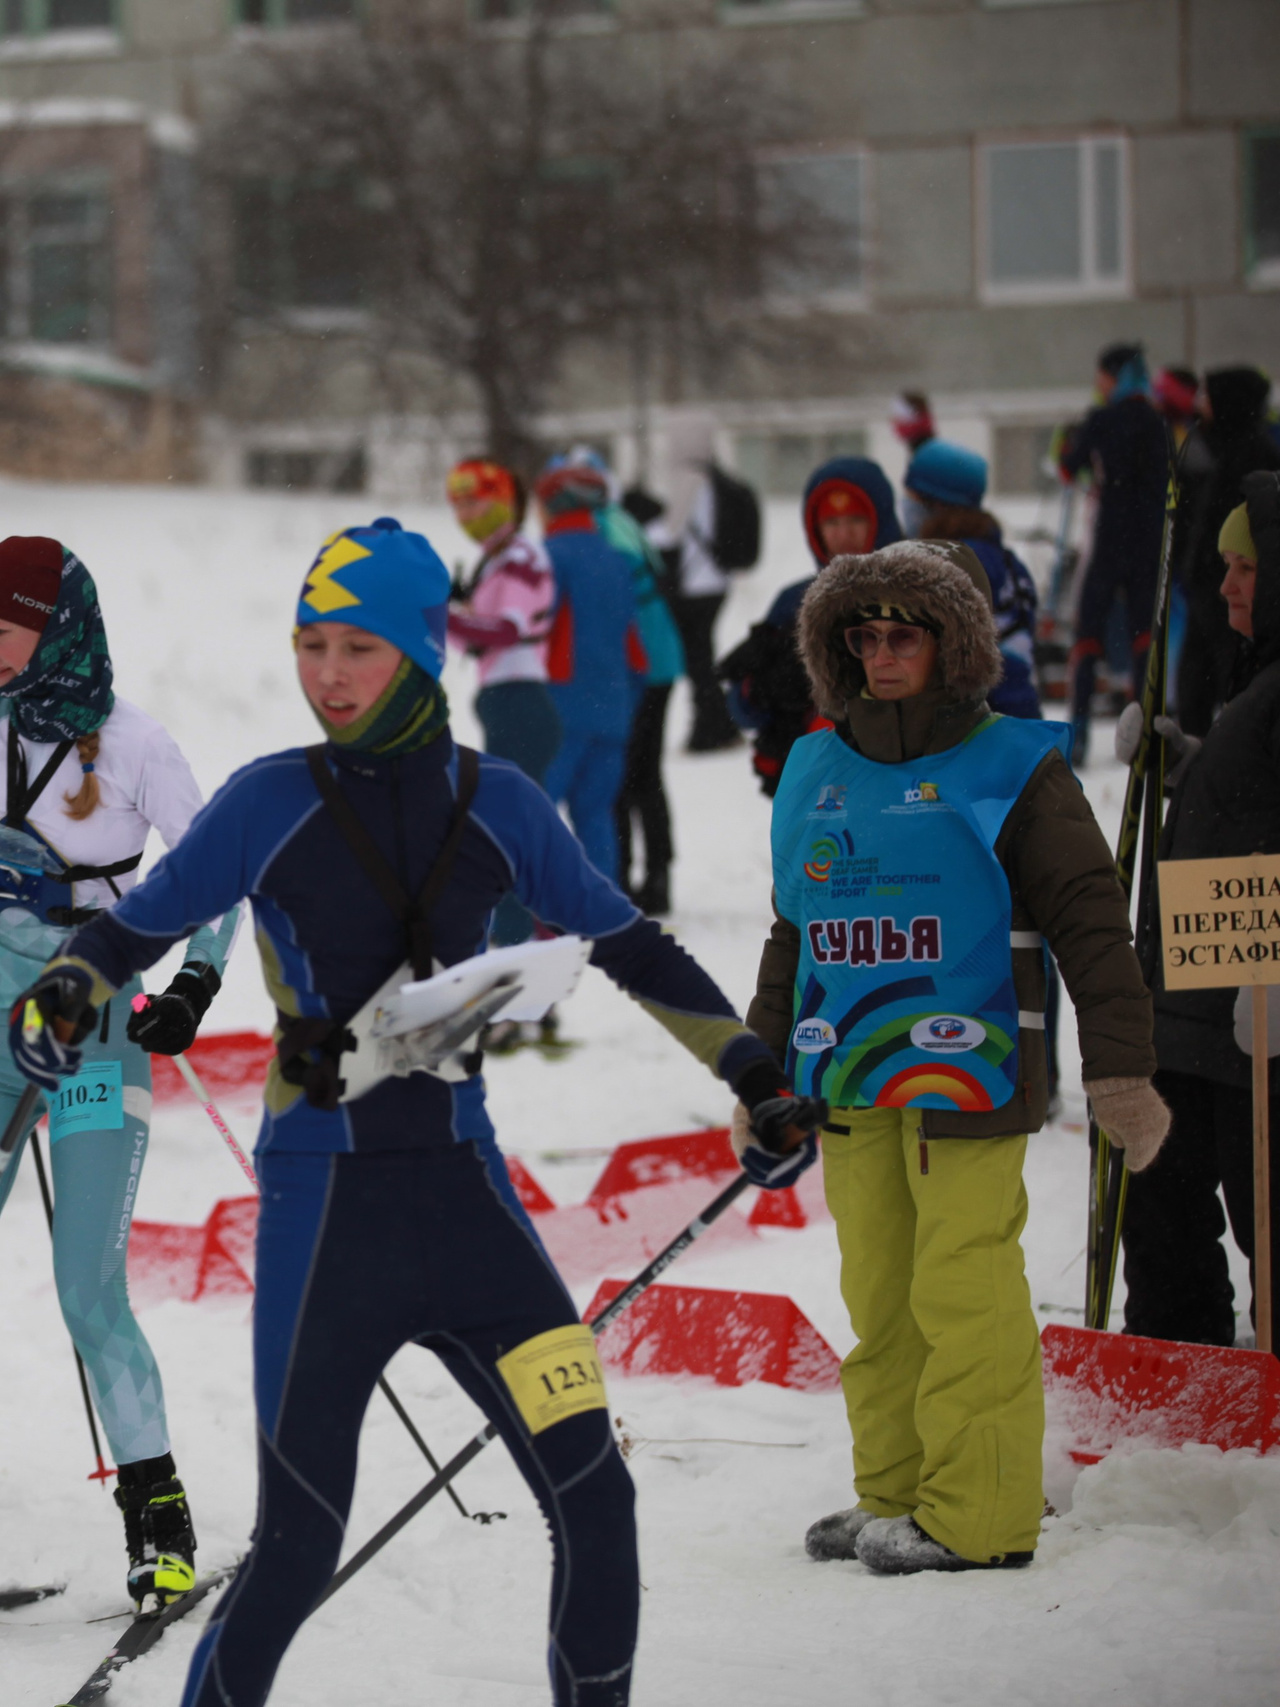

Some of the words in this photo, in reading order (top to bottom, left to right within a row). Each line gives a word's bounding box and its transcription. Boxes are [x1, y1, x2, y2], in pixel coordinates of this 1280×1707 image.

[846, 858, 879, 866] SUMMER
[851, 866, 879, 875] GAMES
[831, 877, 848, 888] WE
[850, 876, 872, 886] ARE
[875, 874, 941, 885] TOGETHER
[831, 887, 867, 899] SPORT
[1208, 876, 1280, 900] ЗОНА
[1172, 908, 1280, 935] ПЕРЕДА
[808, 917, 942, 967] СУДЬЯ
[59, 1082, 109, 1111] 110.2
[115, 1130, 146, 1250] NORDSKI
